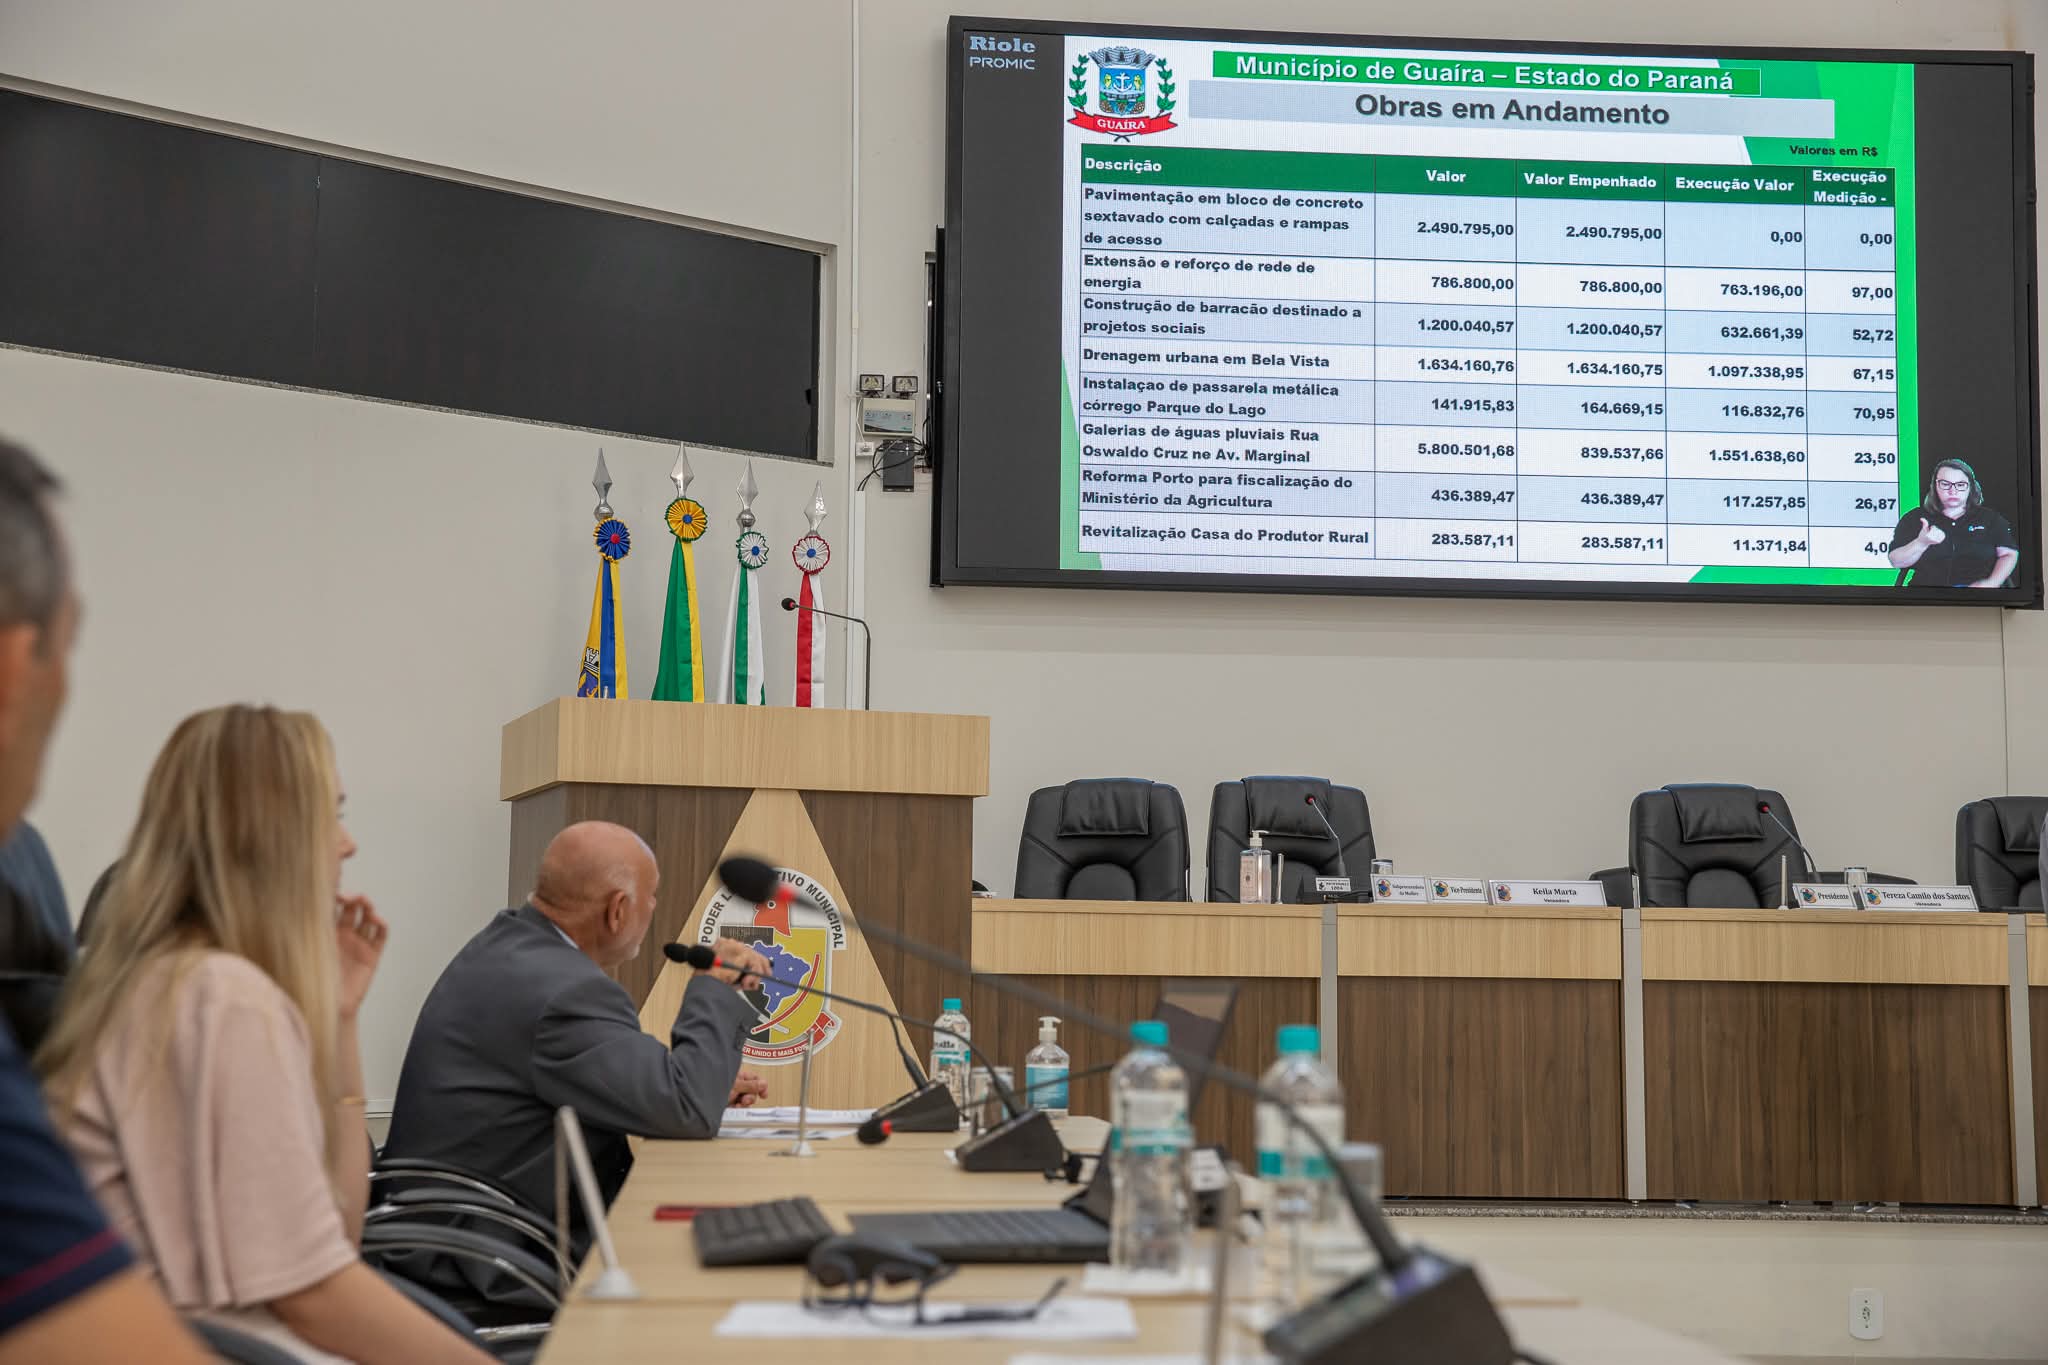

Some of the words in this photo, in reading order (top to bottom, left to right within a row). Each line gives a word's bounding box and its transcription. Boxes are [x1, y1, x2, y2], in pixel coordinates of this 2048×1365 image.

[970, 36, 1035, 53] Riole
[970, 56, 1035, 70] PROMIC
[1235, 56, 1357, 80] Município
[1364, 60, 1394, 79] de
[1402, 60, 1485, 83] Guaíra
[1514, 66, 1600, 88] Estado
[1608, 69, 1639, 88] do
[1648, 69, 1734, 90] Paraná
[1356, 94, 1442, 118] Obras
[1452, 102, 1494, 119] em
[1503, 100, 1669, 124] Andamento
[1097, 117, 1146, 131] GUAÍRA
[1790, 146, 1835, 155] Valores
[1862, 147, 1878, 156] R$
[1085, 158, 1162, 174] Descrição
[1426, 170, 1466, 182] Valor
[1524, 173, 1564, 185] Valor
[1569, 174, 1656, 189] Empenhado
[1813, 170, 1886, 185] Execução
[1676, 177, 1750, 192] Execução
[1754, 179, 1794, 190] Valor
[1085, 188, 1193, 204] Pavimentação
[1198, 195, 1220, 204] em
[1227, 193, 1268, 205] bloco
[1273, 195, 1290, 206] de
[1296, 198, 1363, 208] concreto
[1813, 191, 1876, 205] Medição
[1084, 212, 1164, 223] sextavado
[1169, 216, 1200, 224] com
[1206, 214, 1274, 228] calçadas
[1280, 220, 1288, 228] e
[1294, 220, 1349, 232] rampas
[1418, 222, 1513, 238] 2.490.795,00
[1566, 226, 1662, 241] 2.490.795,00
[1084, 232, 1102, 243] de
[1108, 236, 1162, 245] acesso
[1771, 232, 1802, 244] 0,00
[1860, 234, 1892, 246] 0,00
[1084, 254, 1156, 268] Extensão
[1160, 260, 1169, 268] e
[1175, 258, 1230, 272] reforço
[1235, 260, 1253, 271] de
[1258, 261, 1292, 272] rede
[1297, 262, 1314, 273] de
[1084, 277, 1141, 291] energia
[1432, 277, 1514, 291] 786.800,00
[1580, 281, 1662, 295] 786.800,00
[1721, 284, 1802, 298] 763.196,00
[1852, 287, 1892, 300] 97,00
[1084, 298, 1172, 314] Construção
[1177, 301, 1195, 312] de
[1200, 302, 1268, 314] barracão
[1272, 304, 1348, 316] destinado
[1084, 320, 1146, 336] projetos
[1152, 323, 1205, 334] sociais
[1418, 319, 1514, 334] 1.200.040,57
[1567, 323, 1662, 338] 1.200.040,57
[1721, 327, 1803, 341] 632.661,39
[1853, 329, 1893, 343] 52,72
[1084, 349, 1160, 364] Drenagem
[1166, 352, 1218, 363] urbana
[1223, 356, 1246, 364] em
[1252, 354, 1285, 365] Bela
[1290, 355, 1329, 367] Vista
[1418, 359, 1514, 374] 1.634.160,76
[1568, 362, 1662, 378] 1.634.160,75
[1709, 366, 1804, 380] 1.097.338,95
[1854, 369, 1894, 382] 67,15
[1084, 377, 1164, 392] Instalaçao
[1169, 380, 1188, 391] de
[1193, 382, 1267, 394] passarela
[1273, 384, 1338, 396] metálica
[1083, 399, 1141, 414] córrego
[1148, 401, 1200, 416] Parque
[1206, 403, 1223, 414] do
[1229, 403, 1266, 418] Lago
[1432, 398, 1514, 413] 141.915,83
[1581, 402, 1663, 416] 164.669,15
[1722, 405, 1804, 420] 116.832,76
[1854, 408, 1894, 421] 70,95
[1083, 424, 1146, 436] Galerias
[1151, 426, 1170, 437] de
[1175, 426, 1220, 440] águas
[1226, 428, 1284, 441] pluviais
[1290, 430, 1318, 441] Rua
[1083, 445, 1148, 457] Oswaldo
[1154, 447, 1188, 459] Cruz
[1193, 451, 1211, 459] ne
[1216, 449, 1240, 460] Av.
[1245, 450, 1309, 464] Marginal
[1418, 443, 1514, 458] 5.800.501,68
[1581, 447, 1663, 462] 839.537,66
[1710, 450, 1805, 464] 1.551.638,60
[1854, 452, 1895, 466] 23,50
[1083, 470, 1147, 482] Reforma
[1153, 472, 1193, 484] Porto
[1199, 476, 1232, 487] para
[1237, 474, 1329, 490] fiscalização
[1334, 477, 1352, 488] do
[1082, 492, 1158, 504] Ministério
[1164, 494, 1181, 505] da
[1186, 495, 1272, 508] Agricultura
[1432, 490, 1514, 504] 436.389,47
[1581, 493, 1664, 507] 436.389,47
[1724, 496, 1806, 510] 117.257,85
[1856, 498, 1896, 512] 26,87
[1082, 525, 1186, 541] Revitalização
[1191, 528, 1229, 540] Casa
[1234, 529, 1252, 540] do
[1258, 530, 1324, 542] Produtor
[1329, 531, 1368, 543] Rural
[1432, 534, 1513, 548] 283.587,11
[1582, 537, 1662, 551] 283.587,11
[1734, 540, 1806, 554] 11.371,84
[1865, 542, 1890, 555] 4,0
[1907, 892, 1931, 900] Camilo
[1933, 892, 1945, 900] dos
[1946, 892, 1970, 900] Santos
[701, 902, 725, 943] PODER
[806, 884, 844, 948] MUNICIPAL
